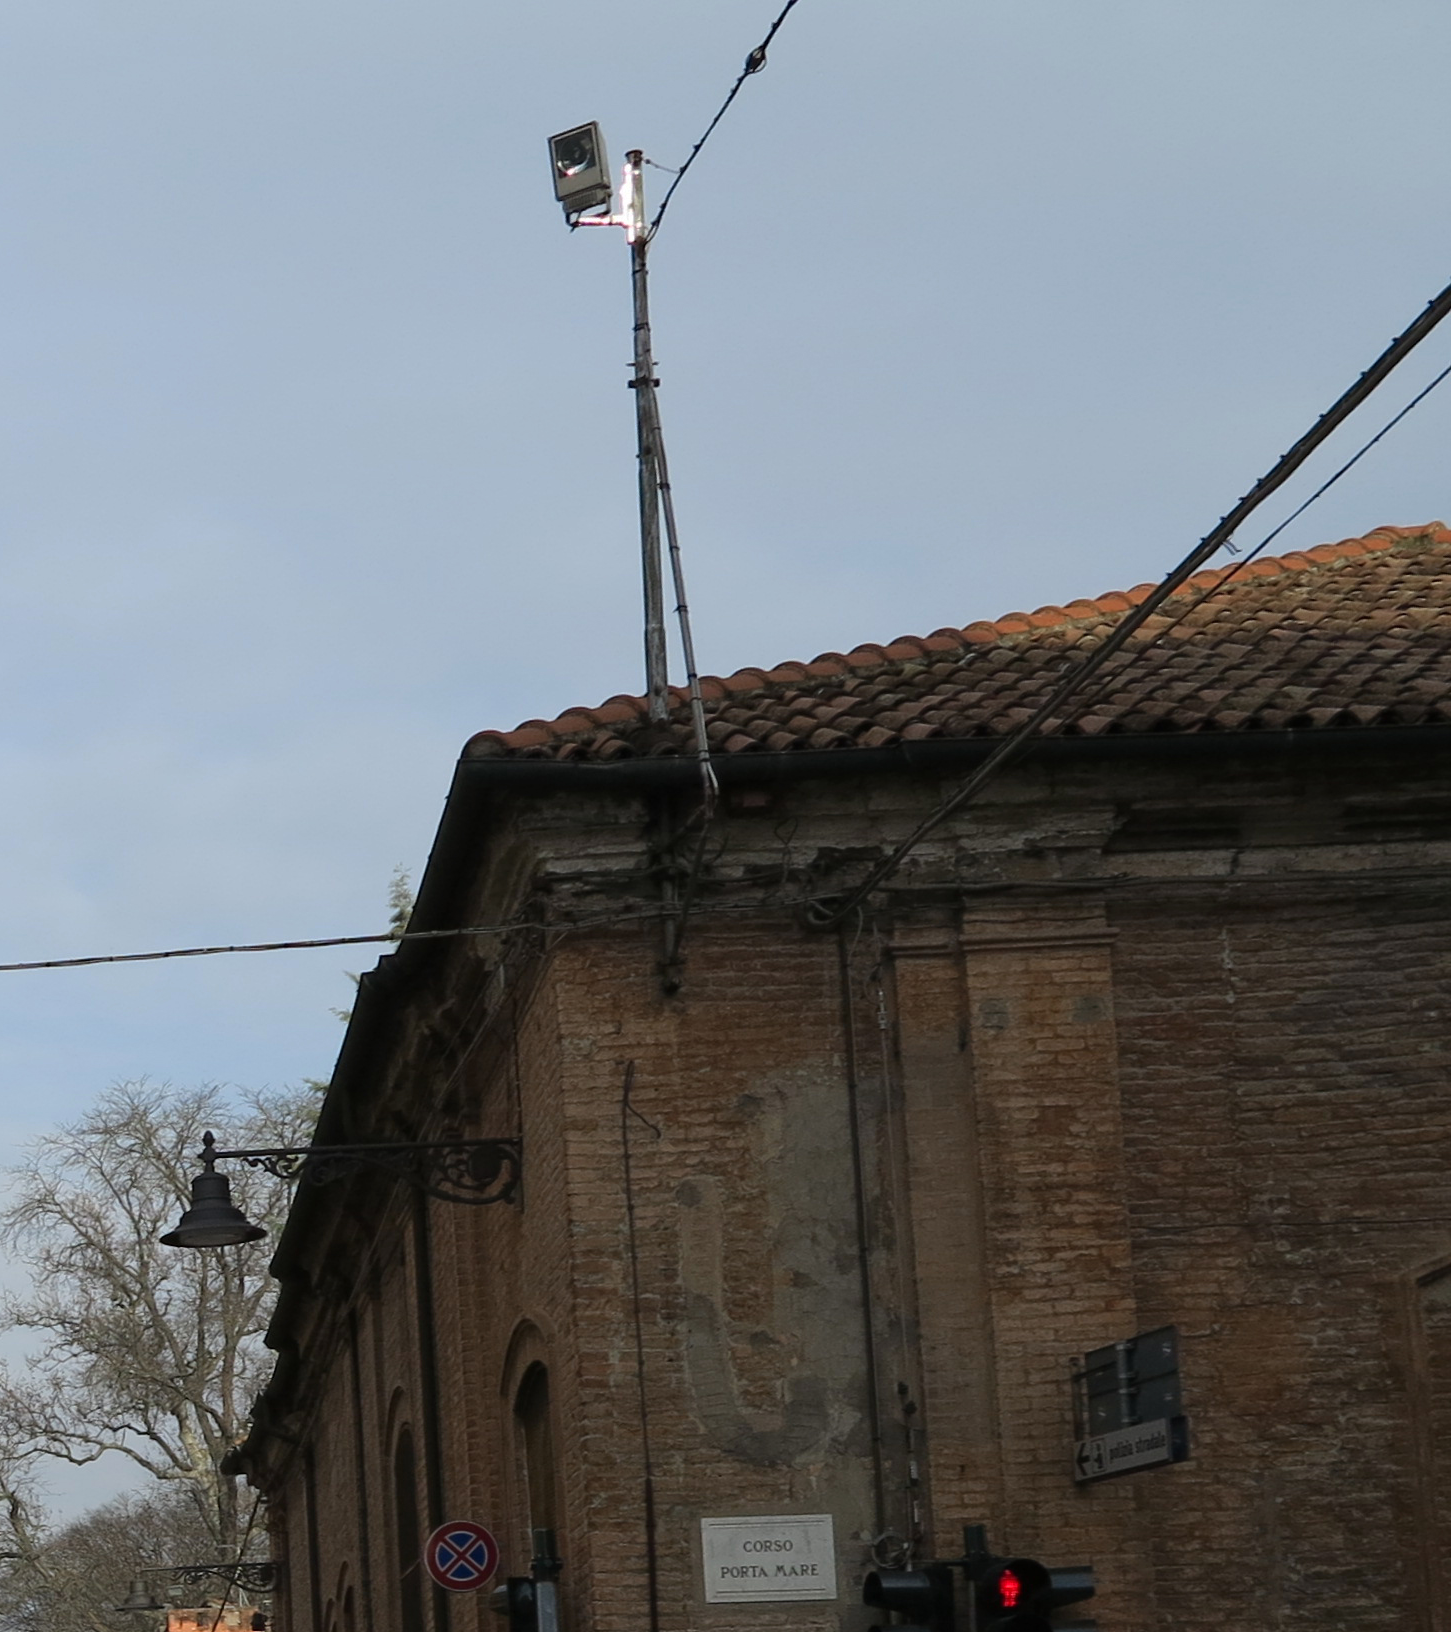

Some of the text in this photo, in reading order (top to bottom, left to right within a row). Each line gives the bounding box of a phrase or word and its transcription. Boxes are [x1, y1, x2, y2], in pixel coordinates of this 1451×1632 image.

[1109, 1439, 1133, 1464] polizia
[743, 1540, 793, 1552] CORSO
[720, 1564, 819, 1579] PORTA MARE
